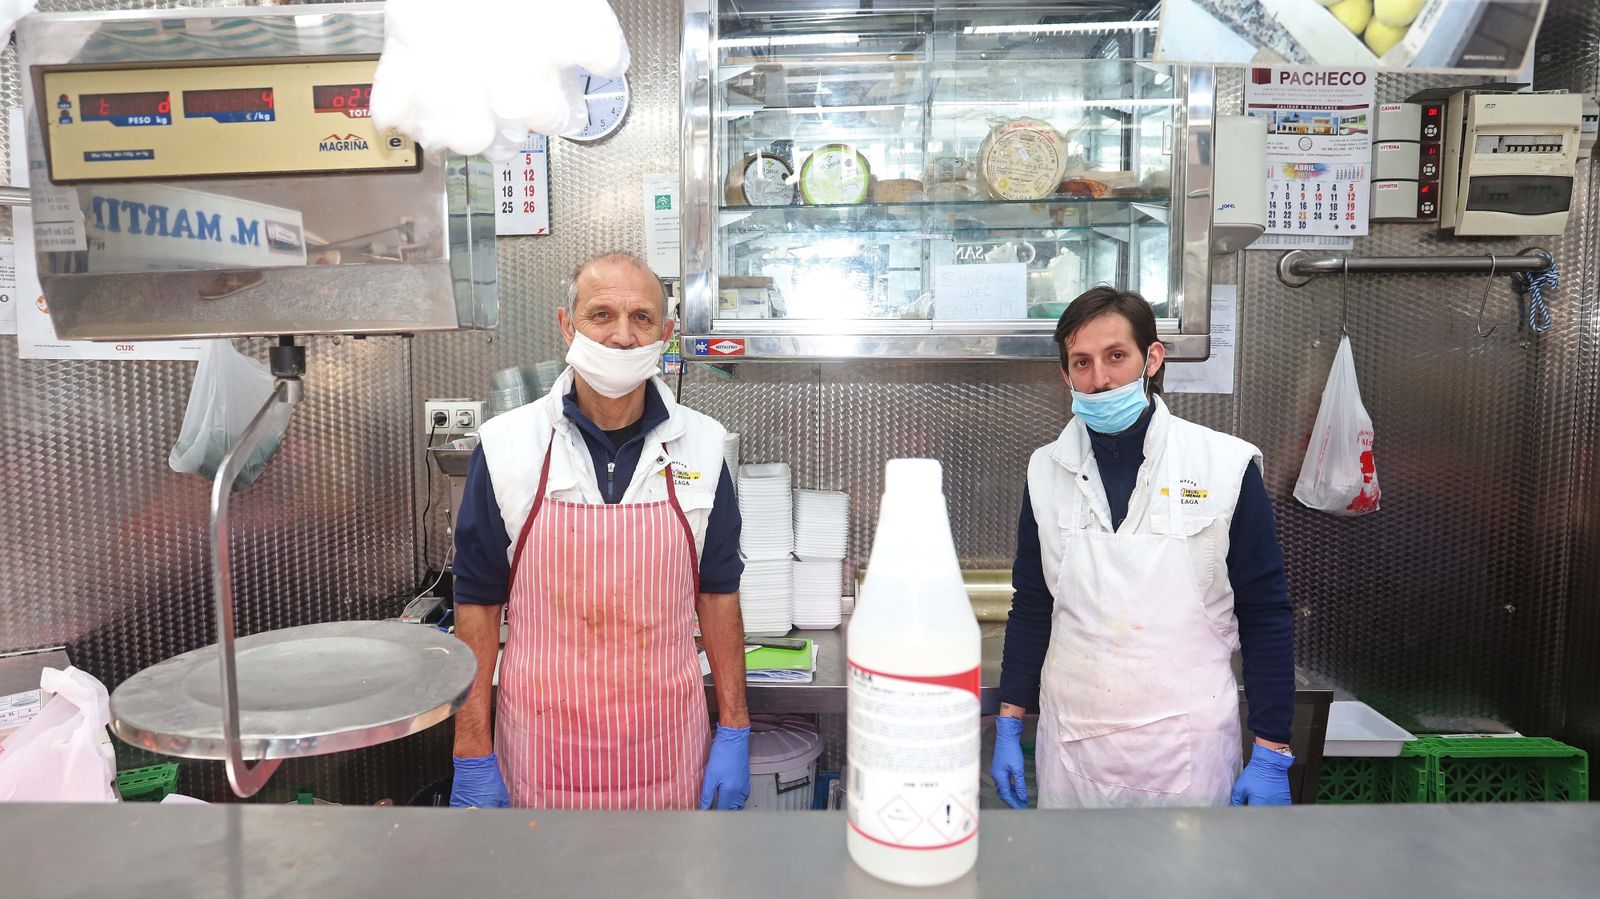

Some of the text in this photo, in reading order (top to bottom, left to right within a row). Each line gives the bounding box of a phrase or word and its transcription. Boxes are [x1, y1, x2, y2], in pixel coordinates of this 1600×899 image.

[1280, 71, 1366, 85] PACHECO
[349, 109, 371, 118] TOTA
[128, 116, 168, 125] PESO kg
[601, 119, 606, 127] 5
[319, 138, 369, 152] MAGRIÑA
[525, 153, 531, 165] 5
[502, 169, 535, 181] 11 12
[502, 185, 535, 197] 18 19
[1301, 183, 1305, 191] 2
[1285, 192, 1290, 200] 8
[1315, 193, 1322, 201] 10
[1331, 193, 1338, 201] 11
[1347, 193, 1355, 201] 12
[502, 201, 535, 213] 25 26
[1300, 202, 1307, 210] 16
[1283, 211, 1291, 219] 22
[1314, 212, 1322, 220] 24
[1268, 220, 1276, 228] 28
[1298, 221, 1306, 229] 30
